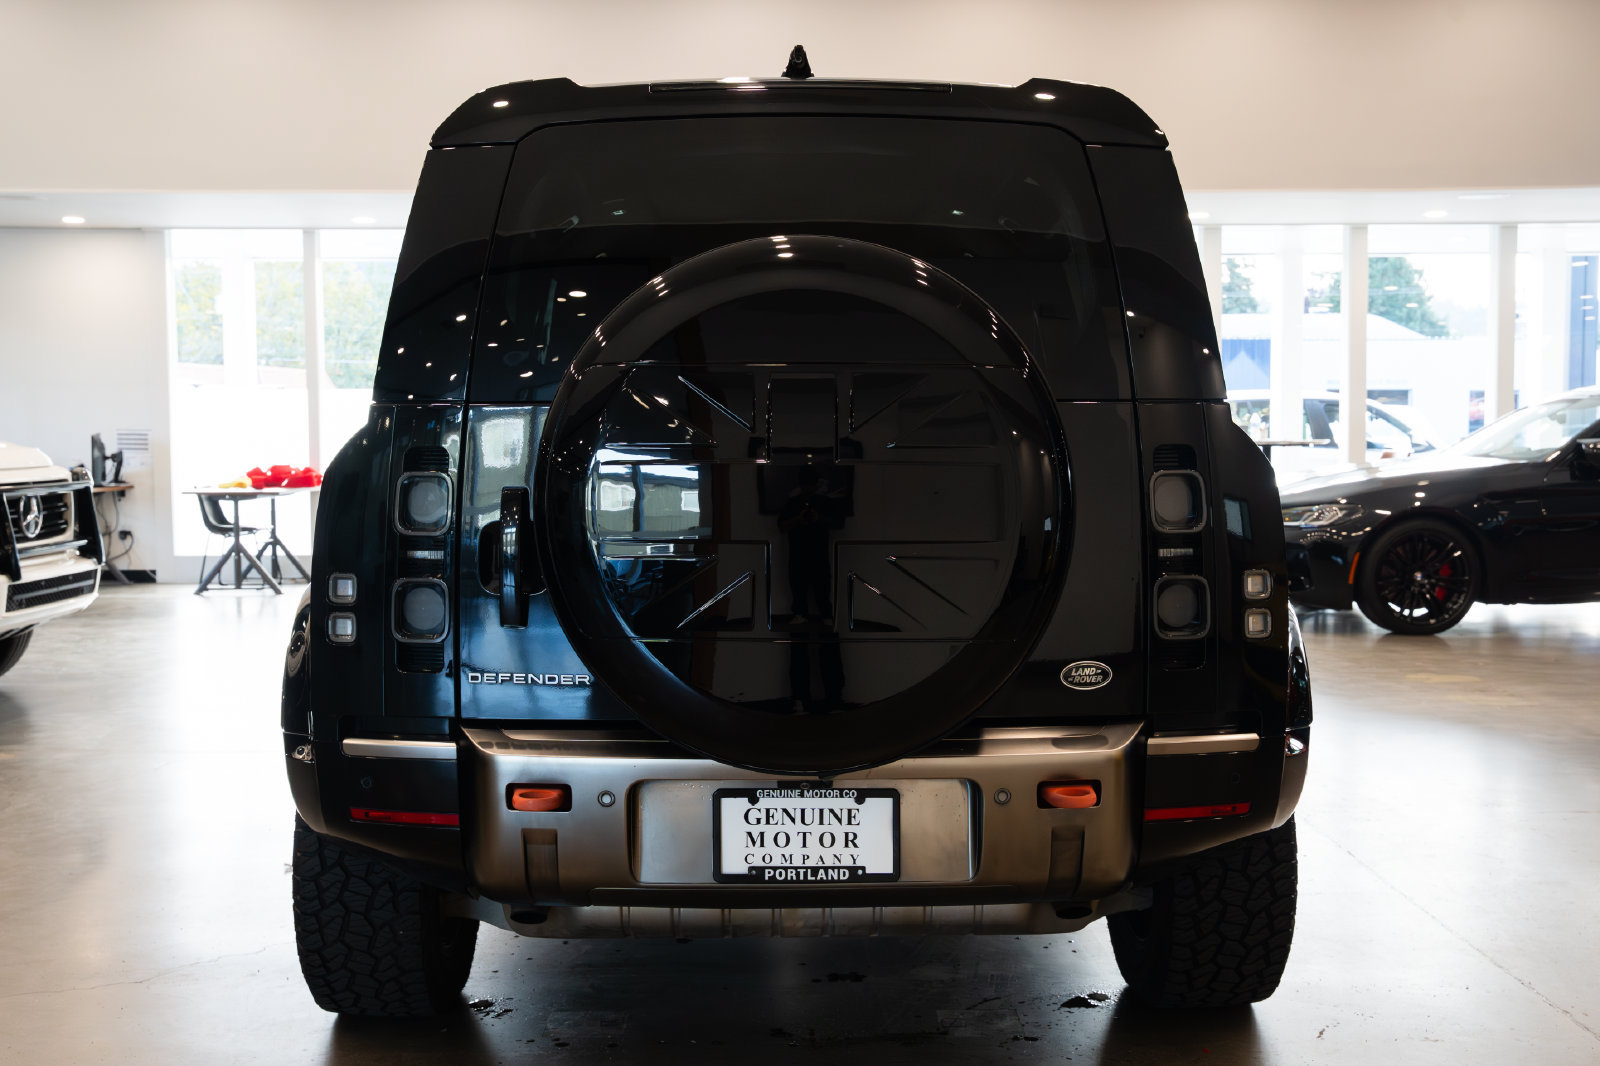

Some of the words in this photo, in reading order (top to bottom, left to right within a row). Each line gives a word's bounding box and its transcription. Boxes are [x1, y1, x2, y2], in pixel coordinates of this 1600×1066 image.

[468, 672, 590, 685] DEFENDER
[756, 789, 801, 798] GENUINE
[804, 789, 840, 798] MOTOR
[843, 789, 857, 798] CO
[743, 807, 861, 826] GENUINE
[744, 831, 860, 849] MOTOR
[744, 853, 861, 865] COMPANY
[764, 868, 850, 881] PORTLAND
